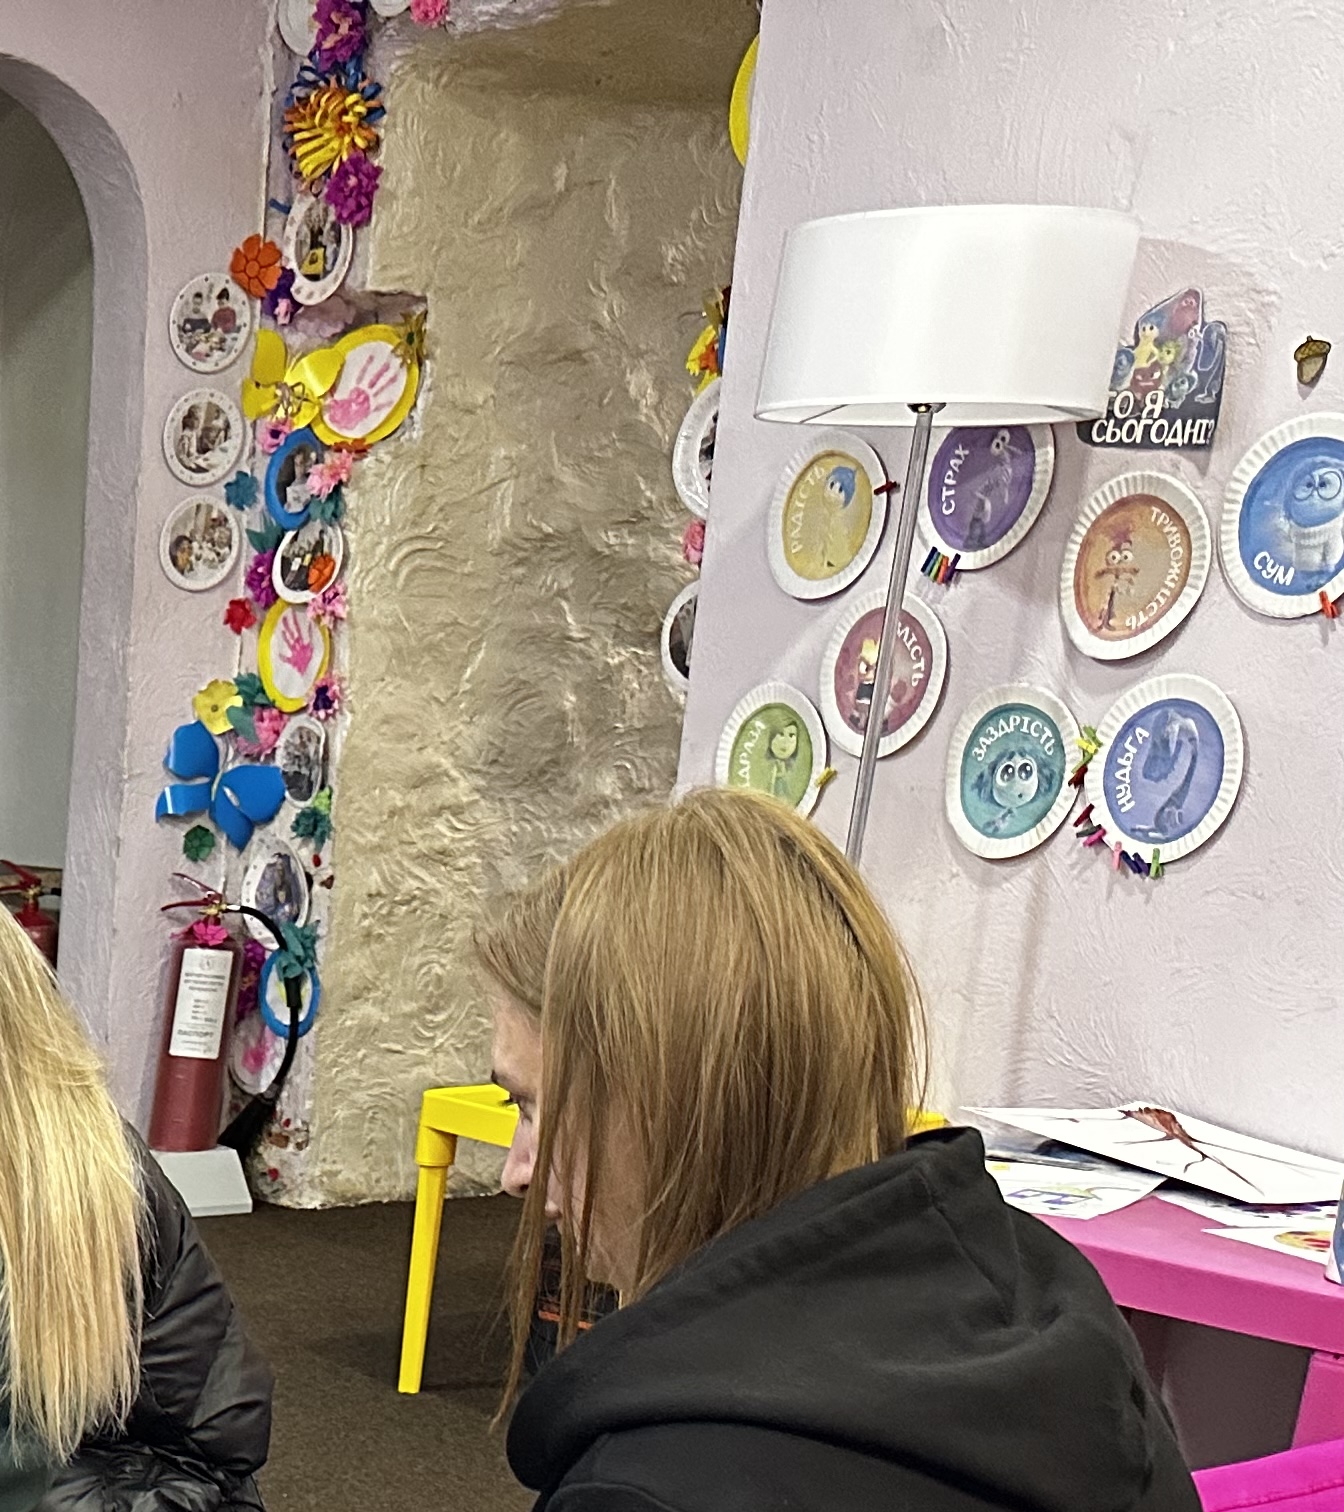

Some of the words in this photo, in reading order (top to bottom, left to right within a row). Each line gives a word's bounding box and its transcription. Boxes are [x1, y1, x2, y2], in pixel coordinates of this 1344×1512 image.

[1141, 390, 1165, 419] Я
[1091, 418, 1216, 447] СЬОГОДНІ?
[941, 443, 970, 516] СТРАХ
[1125, 506, 1183, 631] ТРИВОЖНІСТЬ
[1253, 551, 1295, 586] СУМ
[971, 715, 1056, 761] ЗАЗДРІСТЬ
[1114, 726, 1150, 813] НУДЬГА
